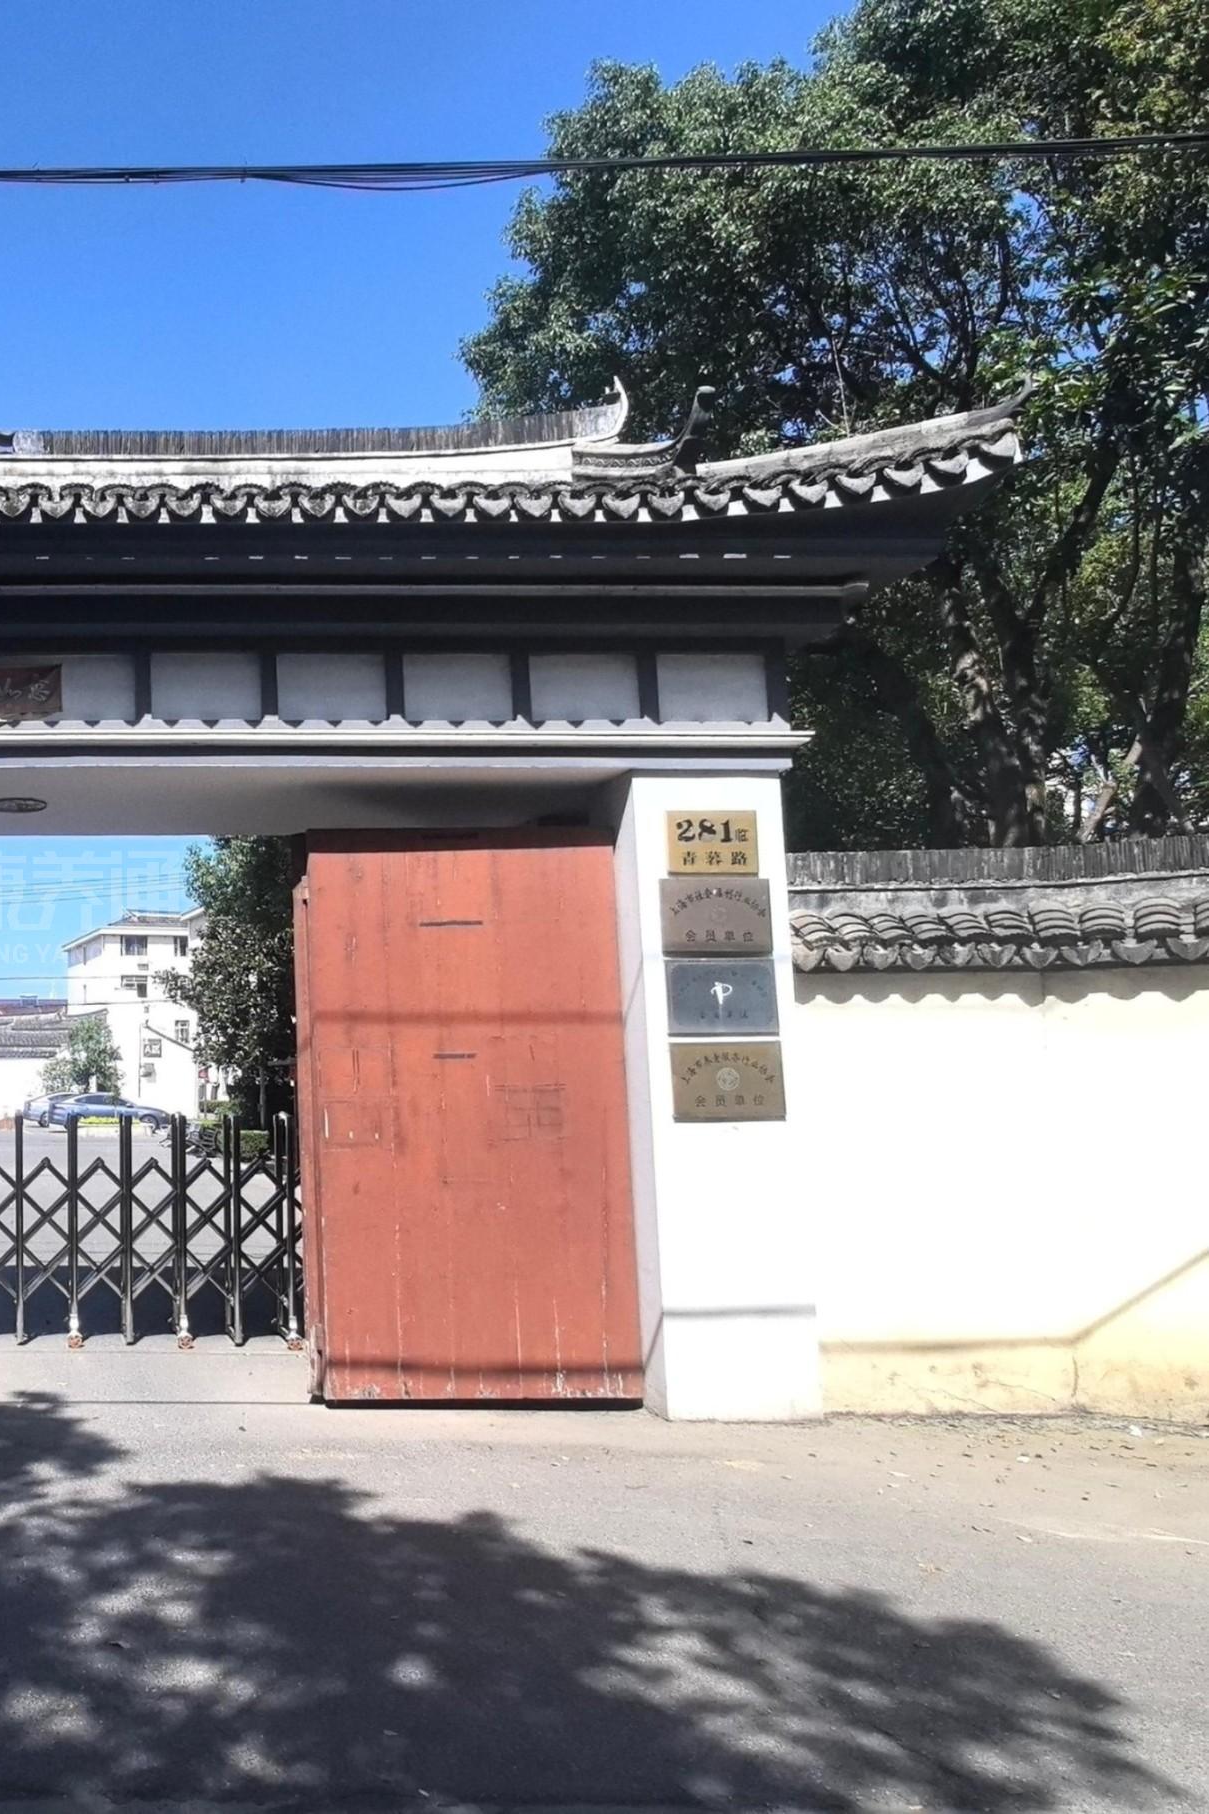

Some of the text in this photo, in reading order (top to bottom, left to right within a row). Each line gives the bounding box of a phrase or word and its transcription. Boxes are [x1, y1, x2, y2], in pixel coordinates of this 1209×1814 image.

[685, 929, 754, 942] 会员单位
[695, 1094, 764, 1107] 会员单位
